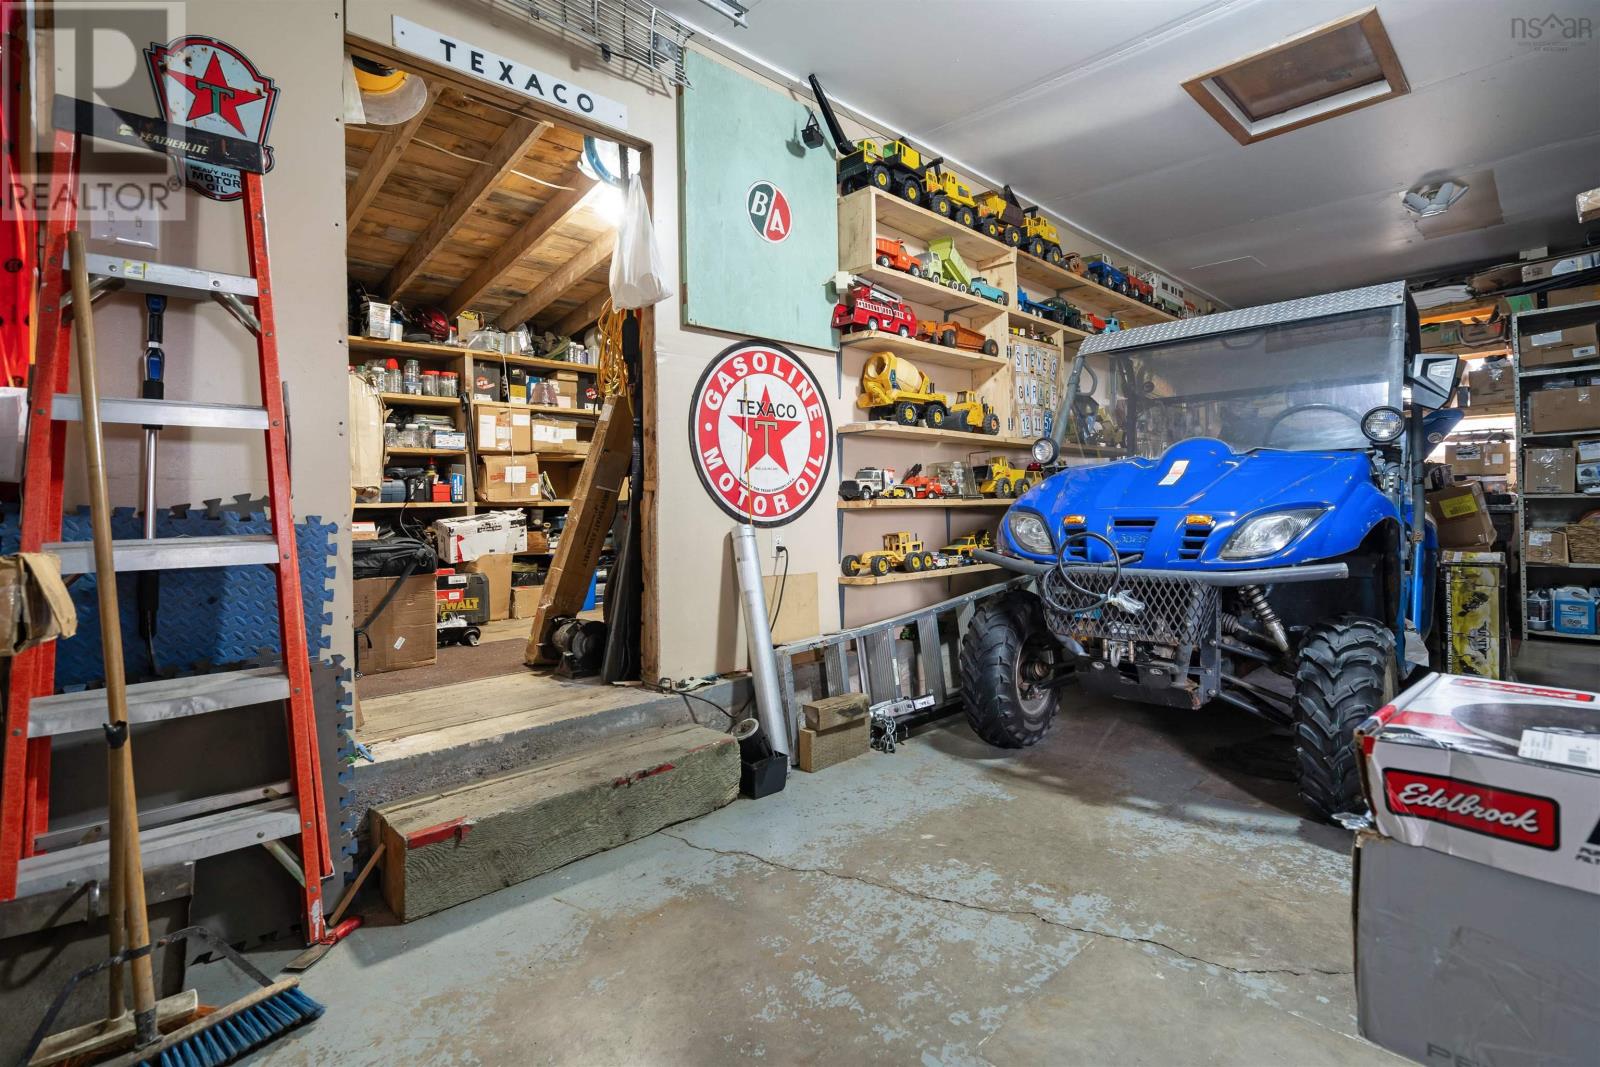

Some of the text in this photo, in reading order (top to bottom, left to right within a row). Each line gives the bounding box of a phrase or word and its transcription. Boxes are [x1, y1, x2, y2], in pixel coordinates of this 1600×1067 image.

[439, 38, 594, 113] TEXACO
[140, 131, 209, 155] FEATHERLITE
[190, 164, 219, 177] HEAVY
[192, 172, 241, 188] MOTOR
[206, 183, 228, 194] OIL
[704, 353, 823, 422] GASOLINE
[736, 399, 797, 419] TEXACO
[703, 446, 824, 515] MOTOR OIL
[1398, 782, 1540, 833] Edelbrock
